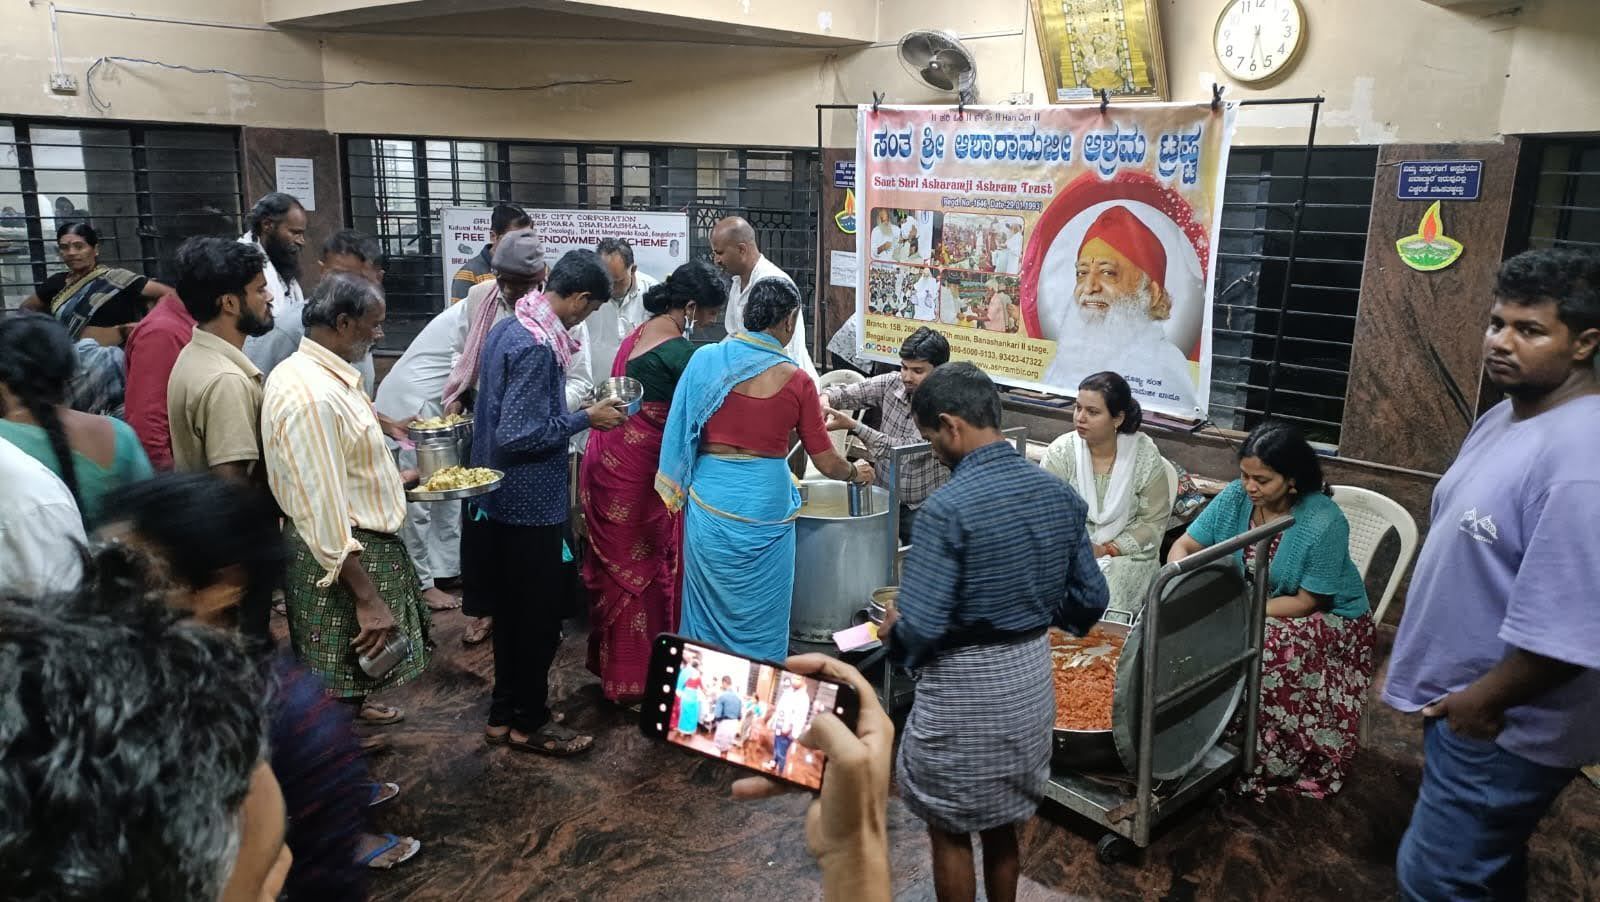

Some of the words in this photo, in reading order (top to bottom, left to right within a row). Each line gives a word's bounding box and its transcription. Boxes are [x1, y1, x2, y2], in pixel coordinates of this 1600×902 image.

[1241, 1, 1250, 14] 11
[1282, 9, 1289, 22] 2
[1283, 26, 1291, 38] 3
[1225, 45, 1233, 57] 8
[1277, 43, 1285, 54] 4
[1237, 56, 1245, 69] 7
[1249, 59, 1257, 71] 6
[1264, 55, 1272, 67] 5
[1003, 113, 1016, 121] Hari
[874, 126, 912, 158] ಸಂತ
[920, 127, 945, 170] ಶ್ರೀ
[1084, 124, 1146, 176] ಆಶ್ರಮ
[874, 176, 896, 187] Sant
[898, 177, 919, 188] Shri
[922, 179, 973, 193] Asharamji
[976, 180, 1017, 193] Ashram
[1021, 182, 1053, 195] Trust
[551, 213, 573, 221] CITY
[577, 214, 636, 223] CORPORATION
[455, 232, 485, 241] FREE
[538, 235, 603, 245] ENDOWMEN
[866, 319, 888, 329] Branch:
[973, 335, 1020, 349] Banashankari
[1027, 344, 1049, 355] stage,
[866, 331, 896, 343] Bengaluru
